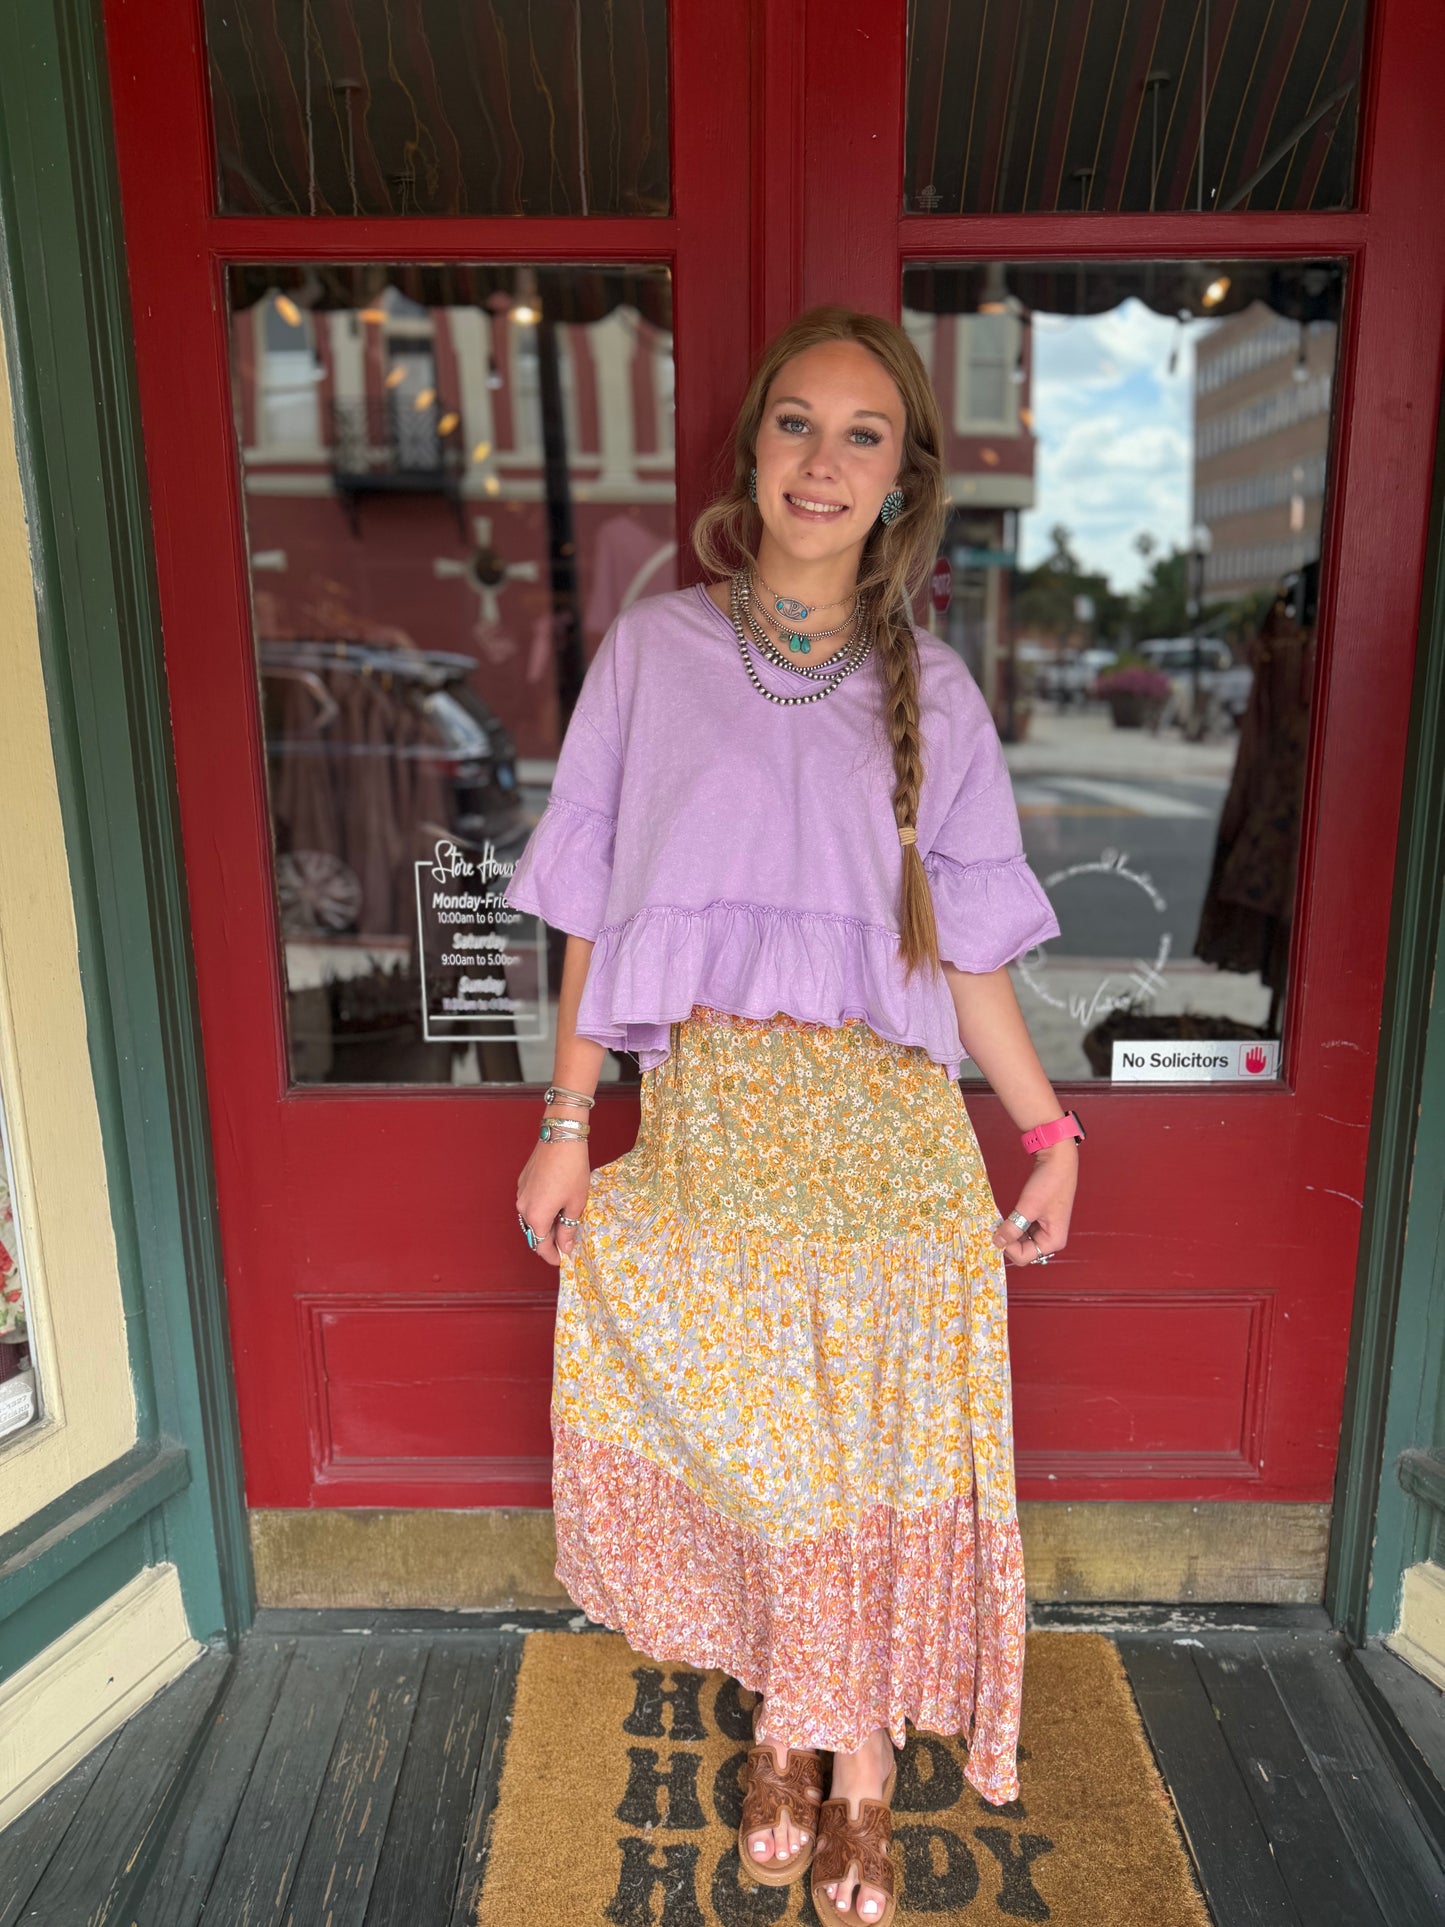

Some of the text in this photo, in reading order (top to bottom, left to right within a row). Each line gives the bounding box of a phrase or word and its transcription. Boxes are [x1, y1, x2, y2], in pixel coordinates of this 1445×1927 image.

[431, 840, 520, 884] Store Hour
[437, 911, 475, 924] 10:00am
[476, 911, 486, 924] to
[441, 953, 475, 966] 9:00am
[476, 953, 486, 966] to
[1122, 1052, 1229, 1068] No Solicitors
[603, 1824, 1055, 1927] HODY
